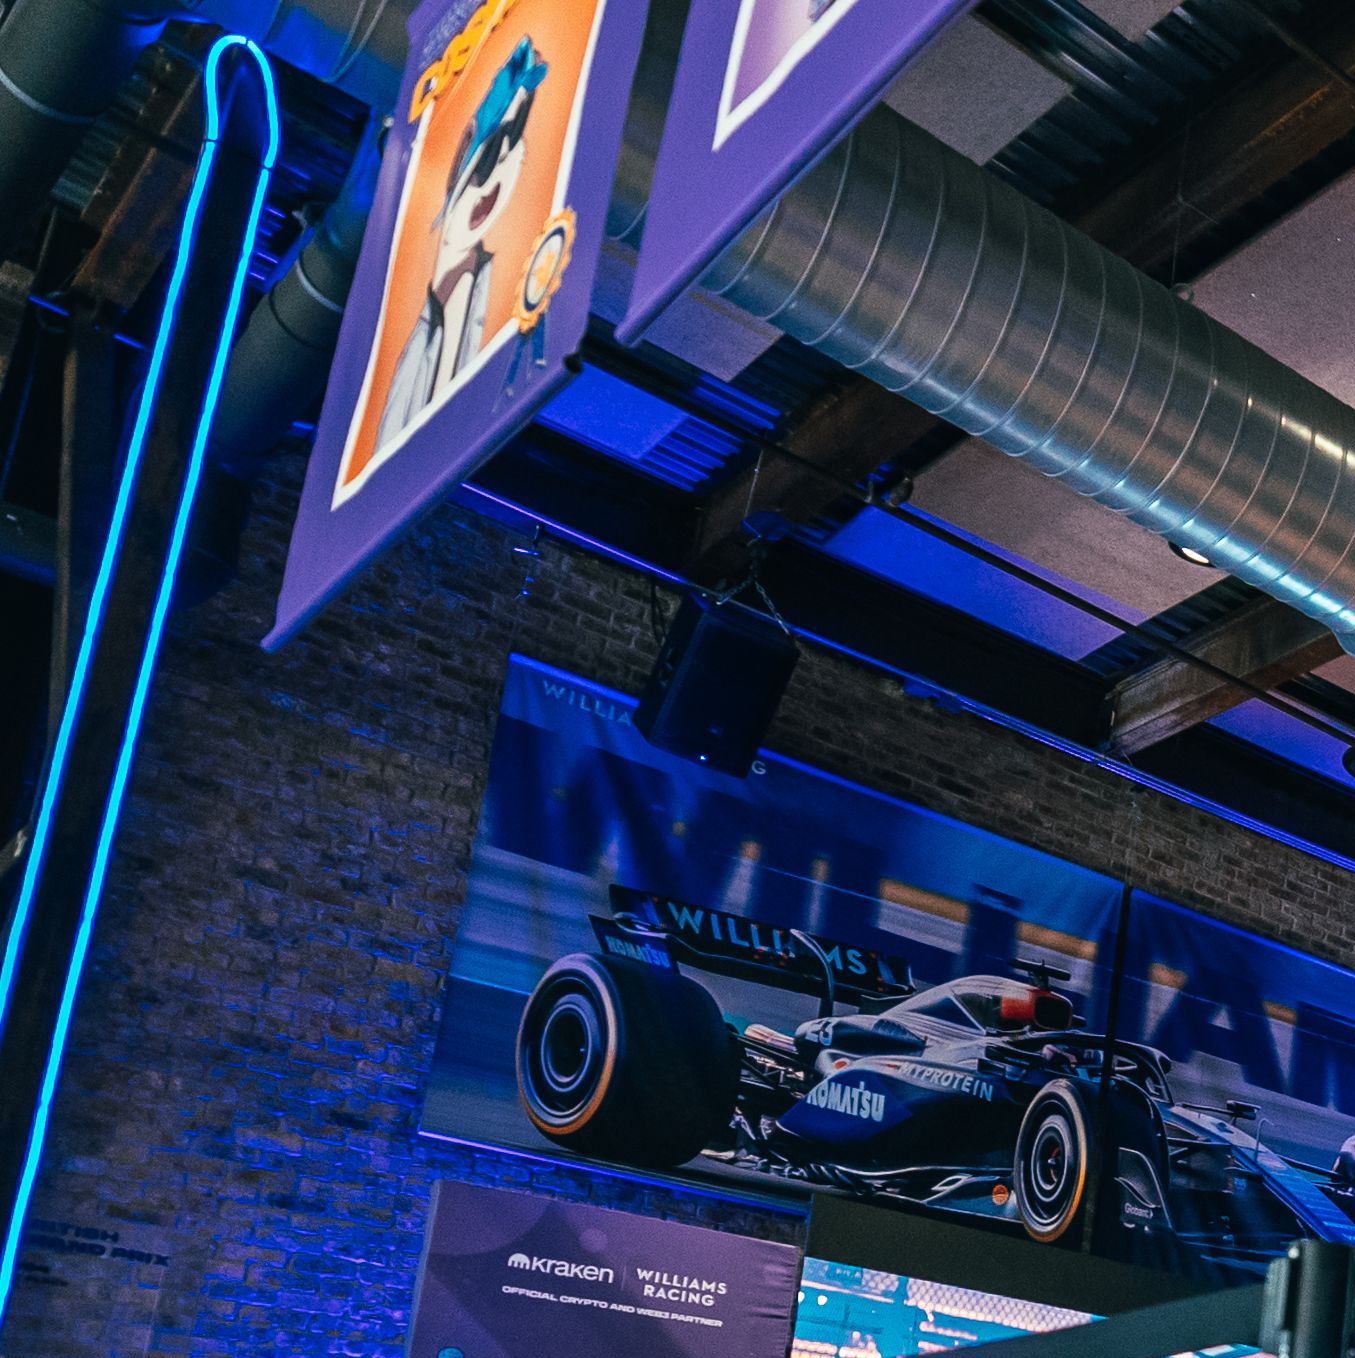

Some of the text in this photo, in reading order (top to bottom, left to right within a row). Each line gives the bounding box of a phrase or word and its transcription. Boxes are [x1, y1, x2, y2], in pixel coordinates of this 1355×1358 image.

[543, 680, 634, 727] WILLIA
[667, 901, 868, 976] WILLIMS
[532, 1256, 614, 1284] kraken
[636, 1268, 728, 1295] WILLIAMS
[502, 1285, 559, 1302] OFFICIAL
[559, 1295, 609, 1310] CRYPTO
[609, 1304, 636, 1314] AND
[670, 1312, 724, 1328] PARTNER
[643, 1284, 715, 1307] RACING
